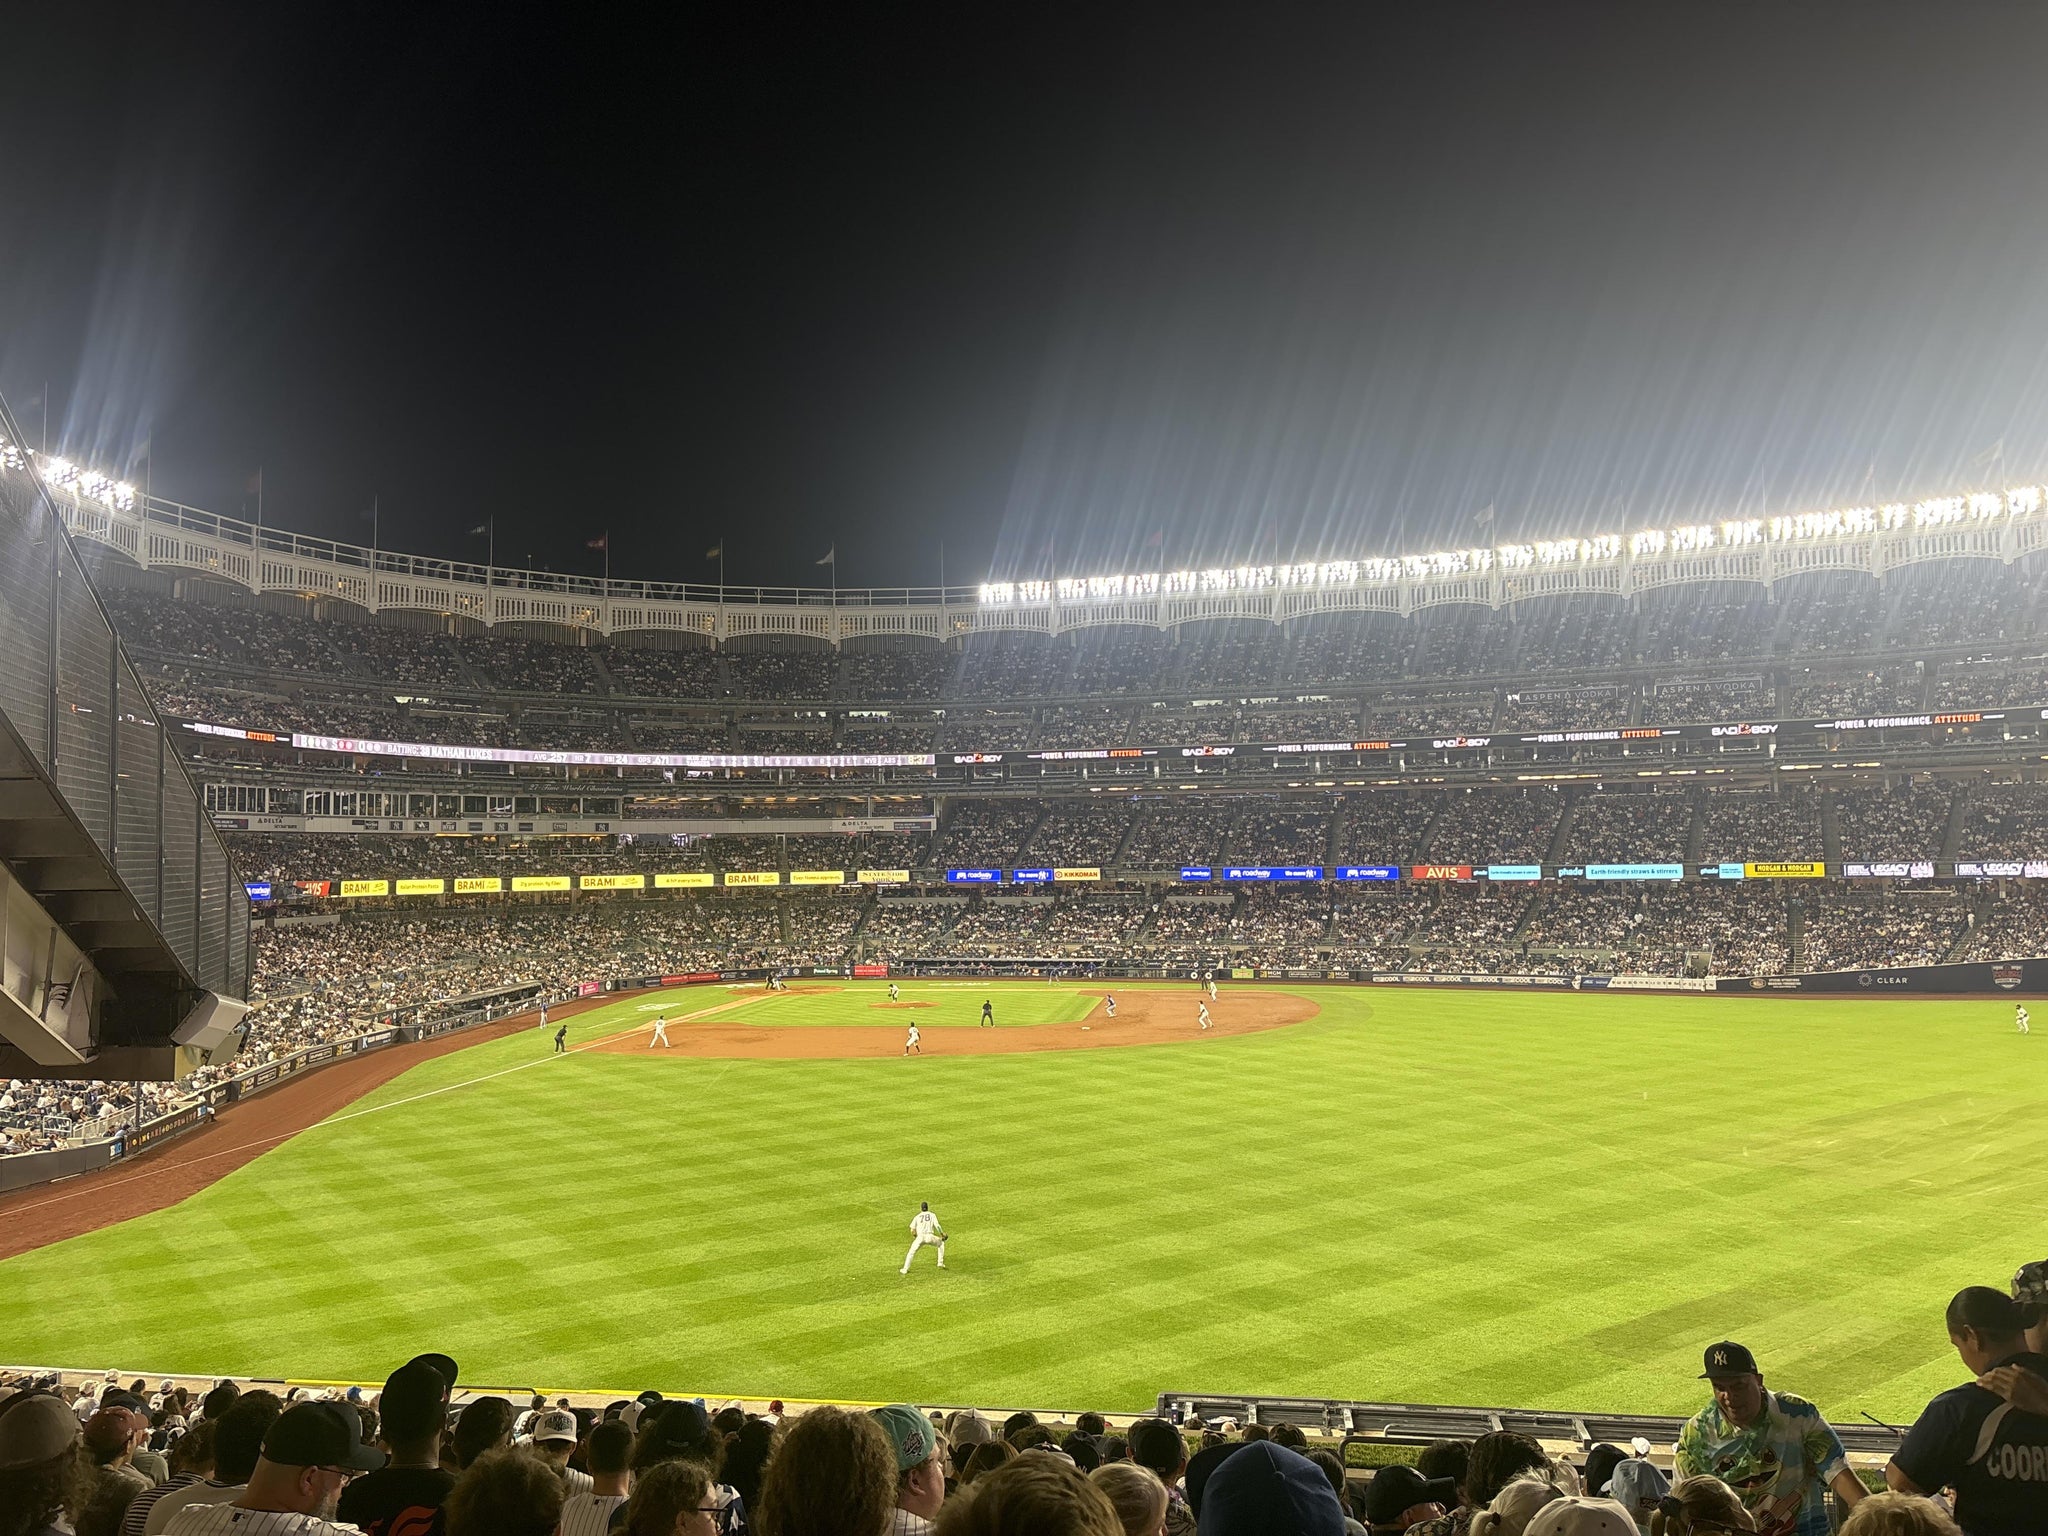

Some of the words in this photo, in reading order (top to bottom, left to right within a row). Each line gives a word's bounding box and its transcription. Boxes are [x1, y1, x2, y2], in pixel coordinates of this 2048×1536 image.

[1661, 685, 1700, 694] ASPEN
[1715, 682, 1755, 691] VODKA
[1524, 692, 1561, 701] ASPEN
[1575, 690, 1611, 699] VODKA
[1835, 720, 1867, 729] POWER.
[1868, 716, 1933, 728] PERFORMANCE.
[1934, 713, 1983, 724] ATTITUDE.
[1538, 734, 1564, 743] POWER.
[1565, 732, 1620, 741] PERFORMANCE.
[1621, 730, 1662, 739] ATTITUDE.
[387, 744, 419, 755] BATTING:
[431, 747, 464, 758] NATHAN
[466, 748, 492, 759] LUKES
[1303, 743, 1352, 752] PERFORMANCE.
[533, 753, 547, 761] AVG
[548, 753, 567, 762] .257
[584, 754, 591, 763] 7
[1064, 751, 1109, 759] PERFORMANCE.
[1109, 749, 1142, 757] ATTITUDE.
[615, 755, 628, 763] 24
[908, 756, 928, 764] 8:37
[586, 784, 623, 793] Champions
[1757, 864, 1780, 872] MORGAN
[1787, 864, 1811, 872] MORGAN
[1870, 864, 1909, 873] LEGACY
[1983, 863, 2024, 872] LEGACY
[967, 871, 992, 880] roadway
[1242, 869, 1270, 878] roadway
[1359, 869, 1388, 878] roadway
[1426, 867, 1458, 878] AVIS
[583, 878, 615, 887] BRAMI
[728, 875, 759, 884] BRAMI
[343, 883, 370, 893] BRAMI
[457, 880, 485, 890] BRAMI
[919, 1213, 931, 1223] 78
[1713, 1350, 1727, 1366] NY
